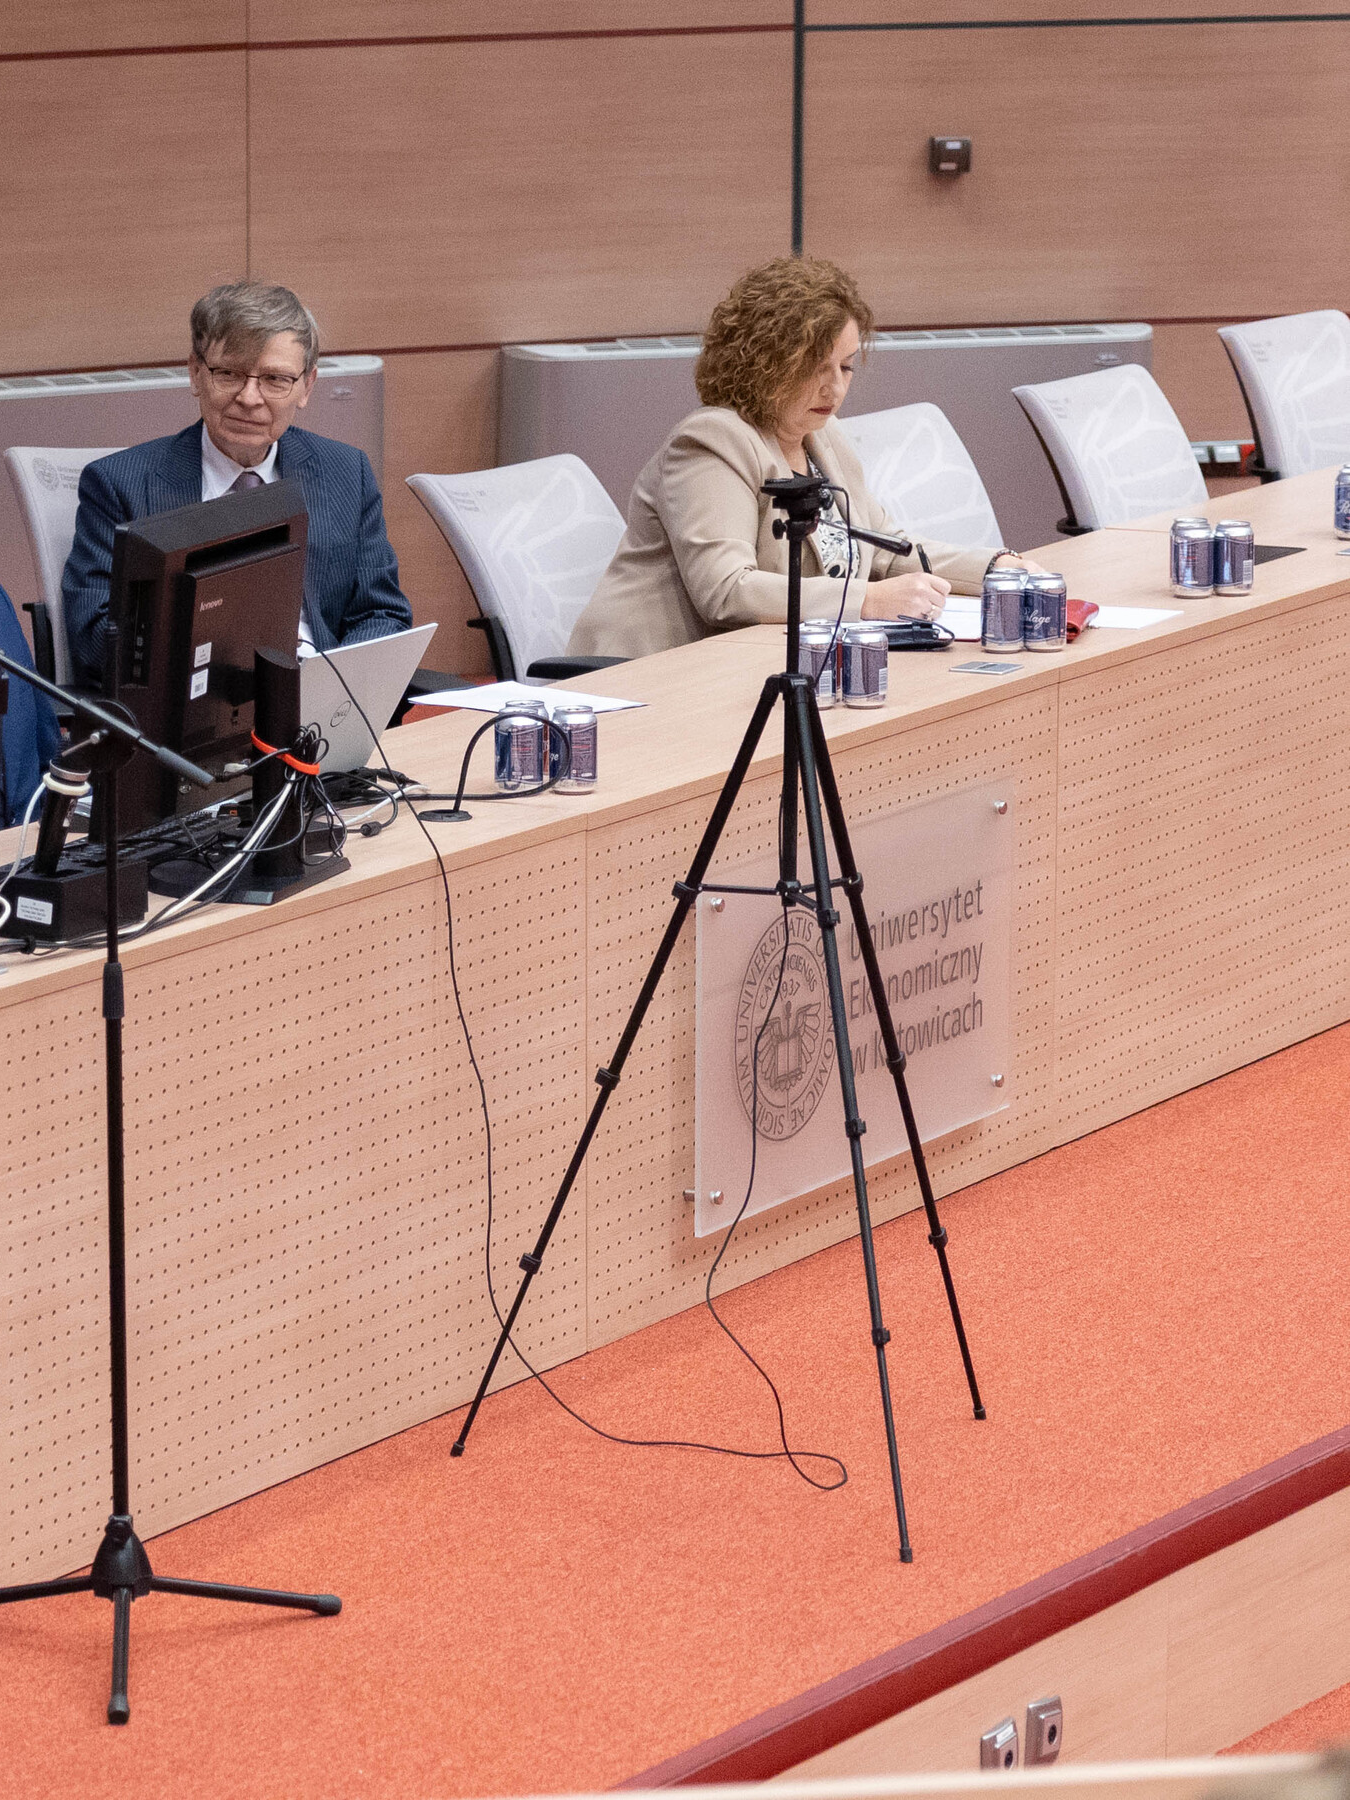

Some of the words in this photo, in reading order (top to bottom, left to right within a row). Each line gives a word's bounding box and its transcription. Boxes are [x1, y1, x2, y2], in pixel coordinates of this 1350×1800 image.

[759, 954, 818, 1010] CATOICIENSIS
[849, 942, 984, 1020] Eknomiczny
[873, 991, 984, 1070] Ktowicach
